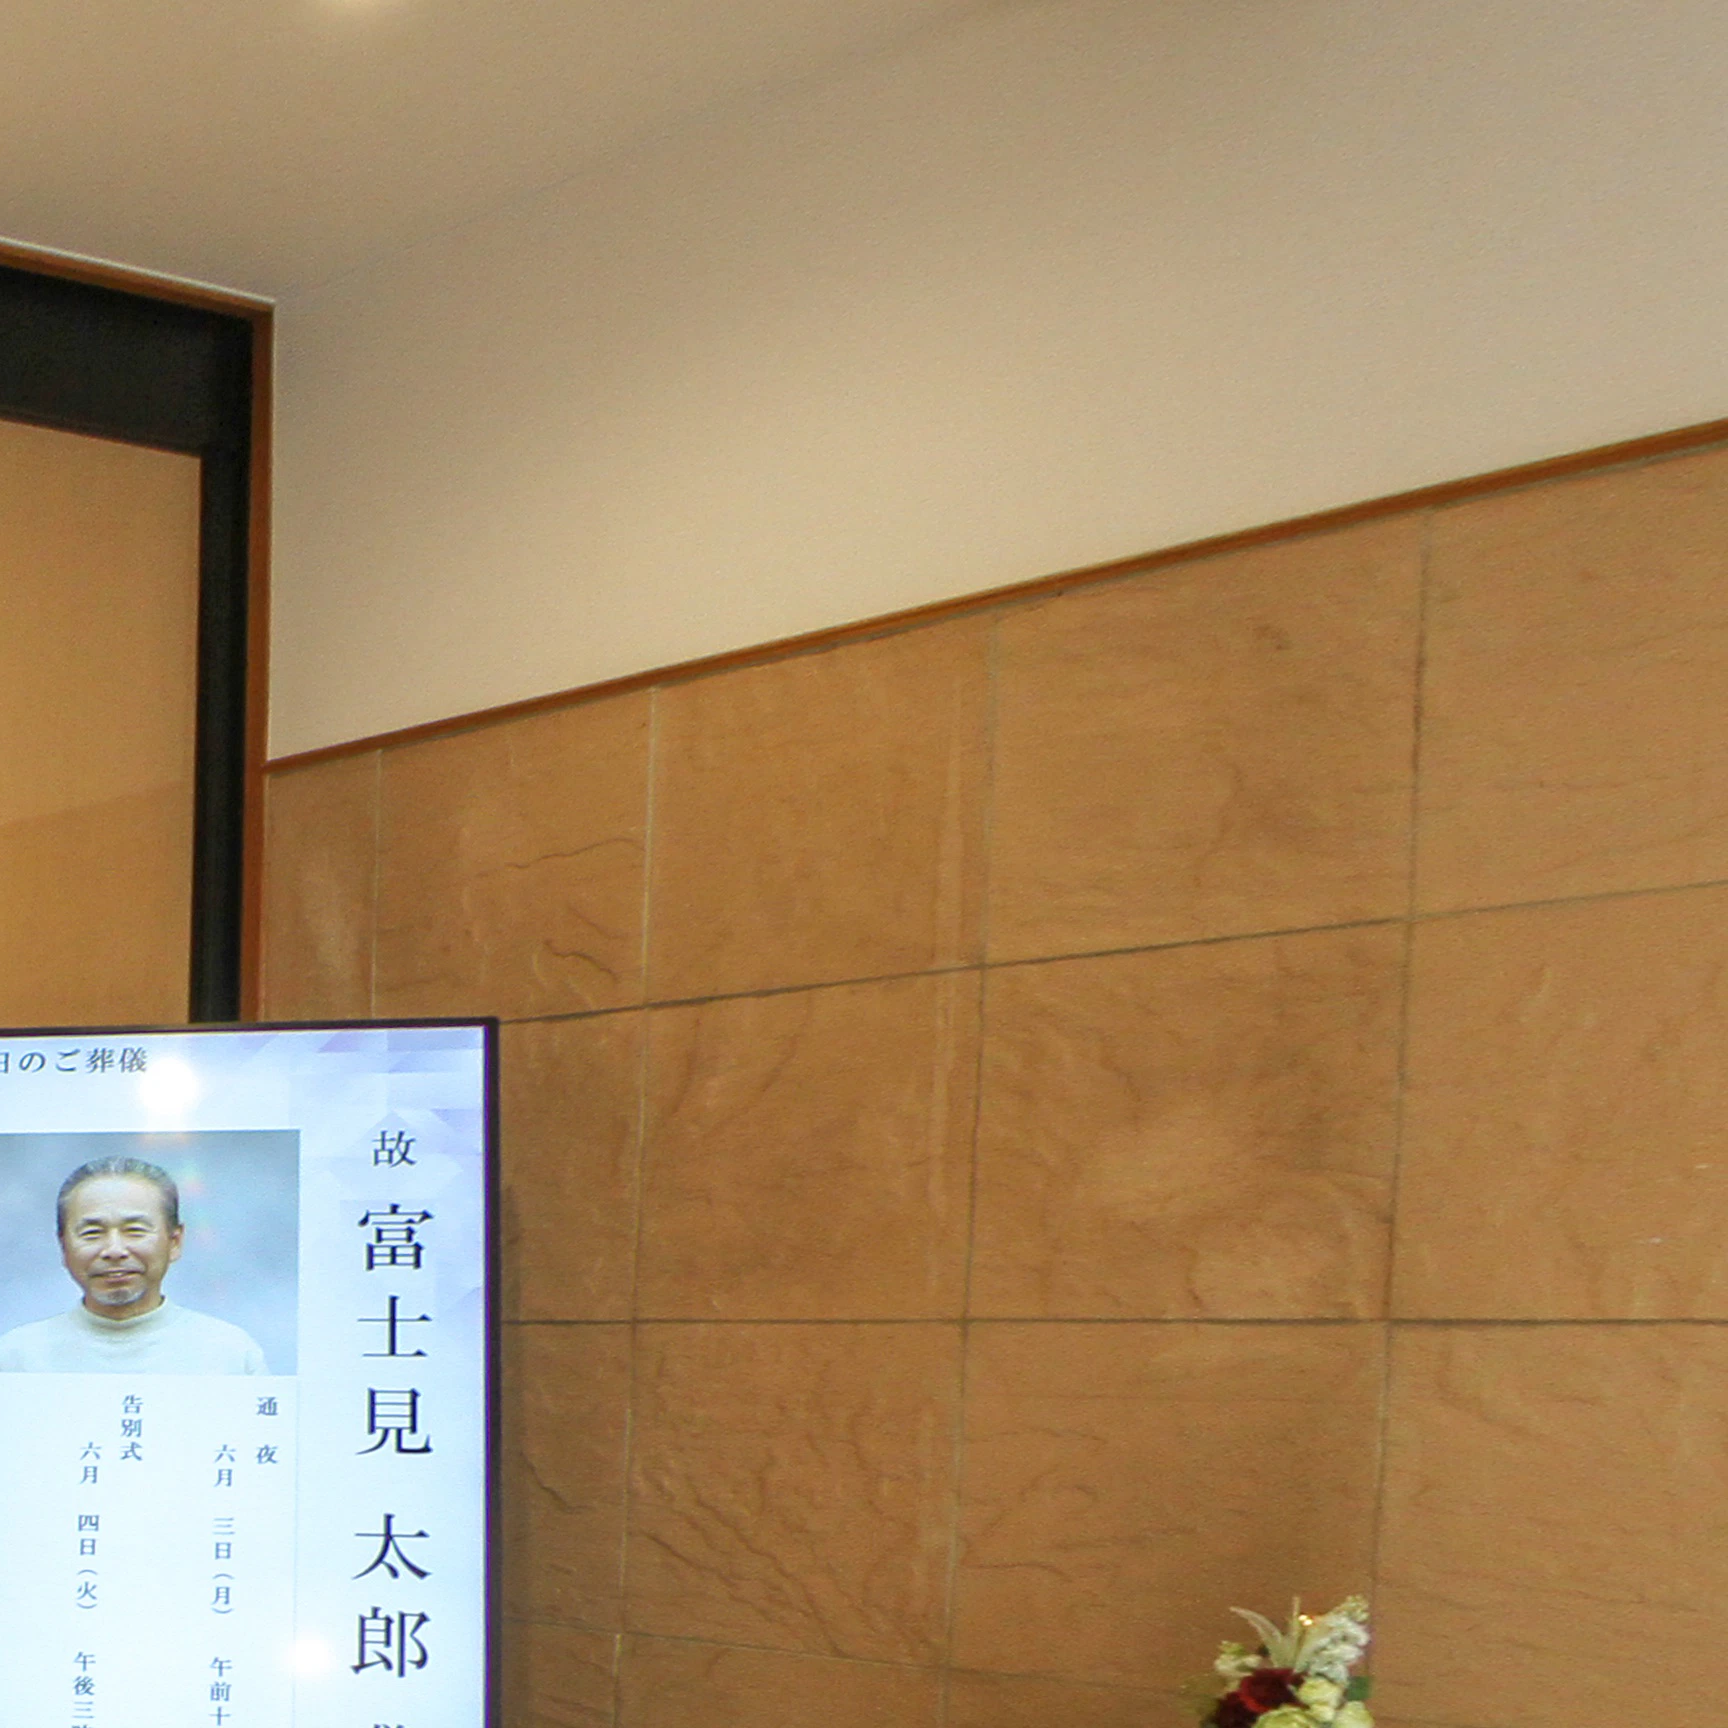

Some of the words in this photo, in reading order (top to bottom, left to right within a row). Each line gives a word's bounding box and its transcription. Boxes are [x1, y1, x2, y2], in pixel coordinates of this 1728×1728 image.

[371, 1130, 418, 1169] 故
[355, 1202, 437, 1456] 富士見
[119, 1394, 144, 1462] 告別式
[79, 1441, 102, 1485] 六月
[214, 1443, 237, 1488] 六月
[349, 1512, 434, 1679] 太郎
